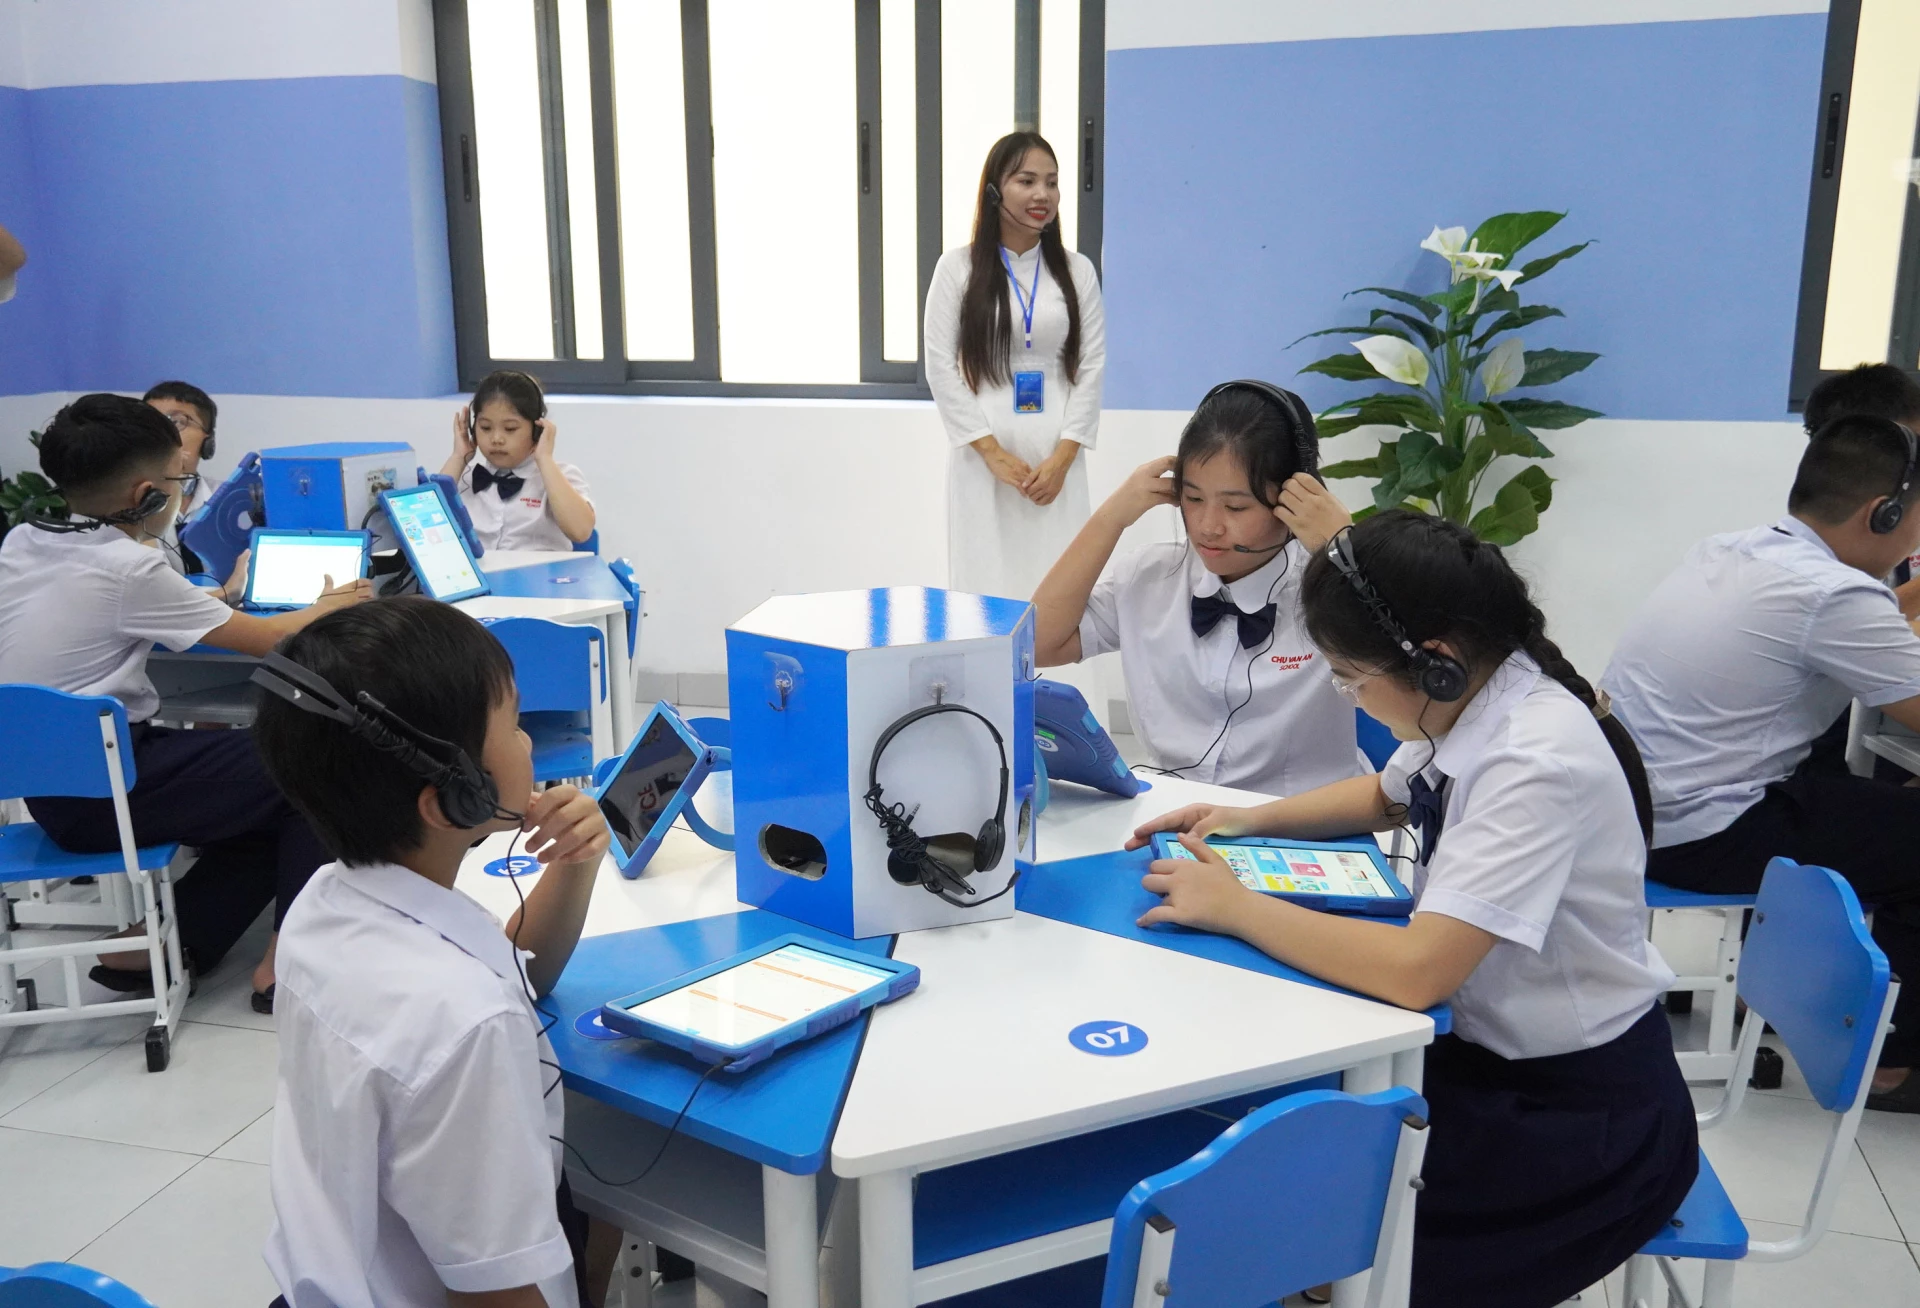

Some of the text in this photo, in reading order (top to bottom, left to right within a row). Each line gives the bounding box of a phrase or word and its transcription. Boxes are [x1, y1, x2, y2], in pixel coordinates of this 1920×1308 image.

[1271, 655, 1287, 663] CHU
[1279, 663, 1299, 671] SCHOOL
[1085, 1025, 1130, 1048] 07
